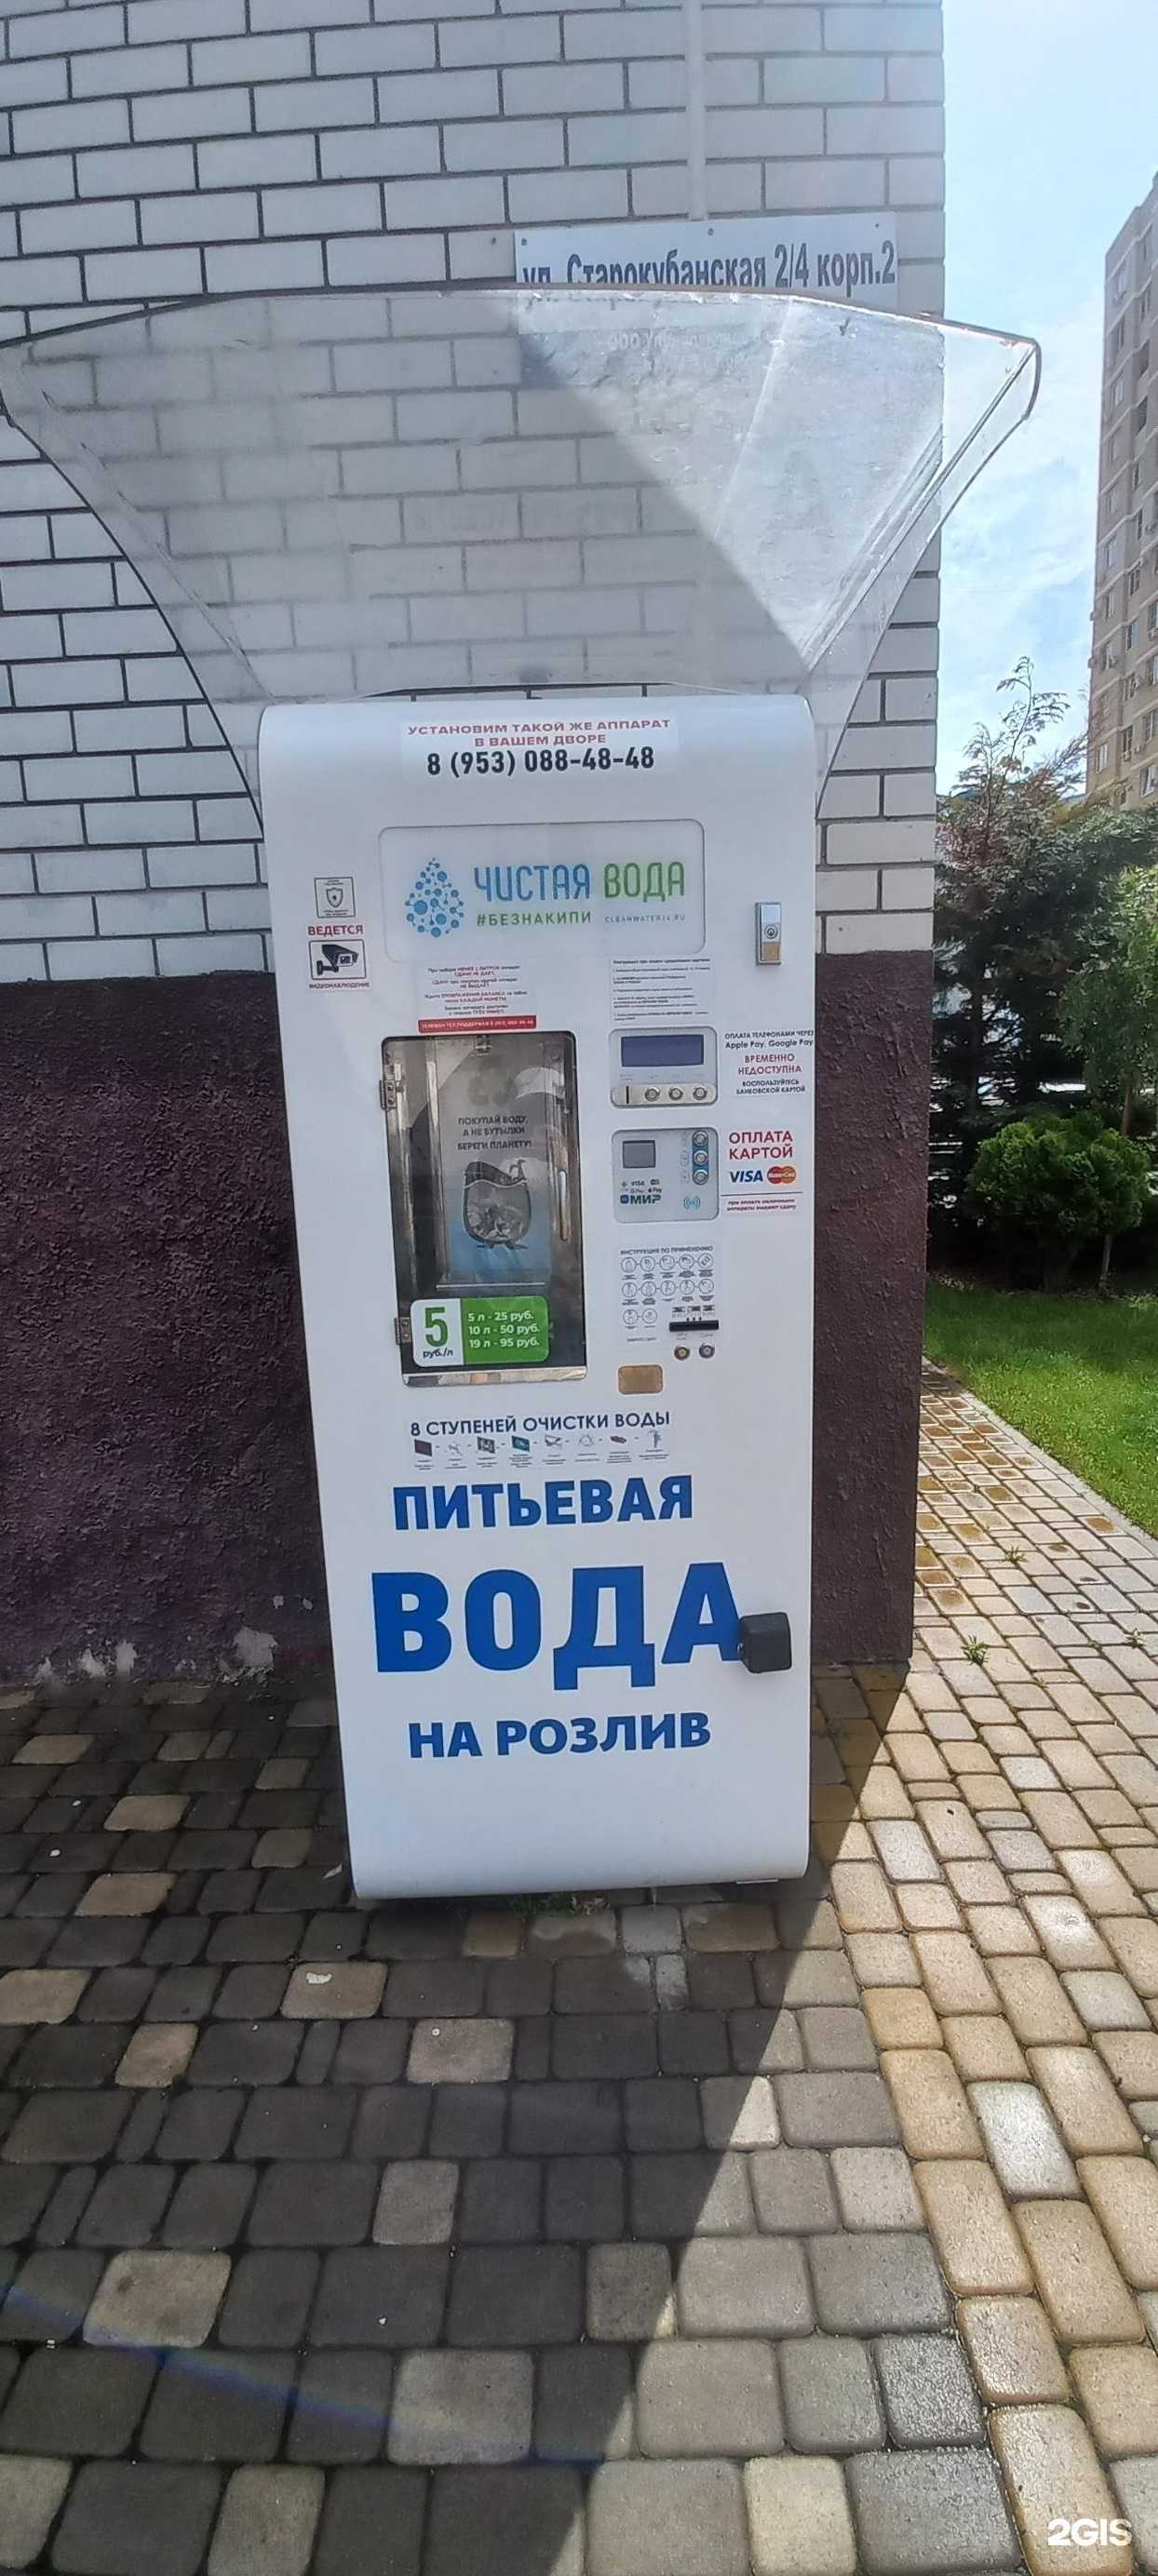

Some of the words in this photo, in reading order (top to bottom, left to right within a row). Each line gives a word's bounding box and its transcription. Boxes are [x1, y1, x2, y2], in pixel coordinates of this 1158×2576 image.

[567, 248, 765, 288] Старокубанская
[774, 243, 809, 288] 2/4
[817, 240, 895, 298] корп.2
[408, 723, 507, 735] УСТАНОВИМ
[512, 720, 564, 733] ТАКОЙ
[570, 721, 592, 731] ЖЕ
[597, 719, 670, 730] АППАРАТ
[475, 737, 485, 747] В
[490, 735, 548, 746] ВАШЕМ
[553, 734, 606, 745] ДВОРЕ
[427, 753, 440, 775] 8
[451, 750, 515, 777] (953)
[524, 747, 654, 771] 088-48-48
[474, 865, 590, 902] ЧИСТАЯ
[604, 862, 685, 903] ВОДА
[477, 911, 591, 926] #БЕЗНАКИПИ
[308, 925, 363, 937] ВЕДЕТСЯ
[725, 1041, 747, 1050] Apple
[769, 1040, 797, 1048] Google
[745, 1053, 794, 1063] ВРЕМЕННО
[738, 1065, 801, 1075] НЕДОСТУПНА
[742, 1079, 799, 1087] ВОСПОЛЬЗУЙТЕСЬ
[458, 1116, 500, 1125] ПОКУПАЙ
[484, 1127, 524, 1135] БУТЫЛКИ
[729, 1131, 793, 1144] ОПЛАТА
[458, 1141, 488, 1150] БЕРЕГИ
[490, 1140, 532, 1149] ПЛАНЕТУ!
[730, 1144, 792, 1160] КАРТОЙ
[728, 1170, 763, 1183] VISA
[630, 1195, 661, 1204] МИР
[468, 1313, 475, 1322] 5
[494, 1312, 507, 1321] 25
[511, 1310, 533, 1322] руб.
[424, 1307, 448, 1347] 5
[469, 1326, 479, 1335] 10
[500, 1325, 514, 1334] 50
[517, 1323, 540, 1335] руб.
[469, 1339, 479, 1348] 19
[500, 1338, 513, 1347] 95
[517, 1337, 540, 1348] руб.
[424, 1348, 453, 1360] руб./л
[411, 1423, 421, 1436] 8
[426, 1415, 517, 1436] СТУПЕНЕЙ
[523, 1414, 608, 1431] ОЧИСТКИ
[615, 1412, 669, 1429] ВОДЫ
[393, 1474, 693, 1530] ПИТЬЕВАЯ
[371, 1562, 744, 1691] ВОДА
[409, 1722, 482, 1758] НА
[496, 1711, 710, 1757] РОЗЛИВ
